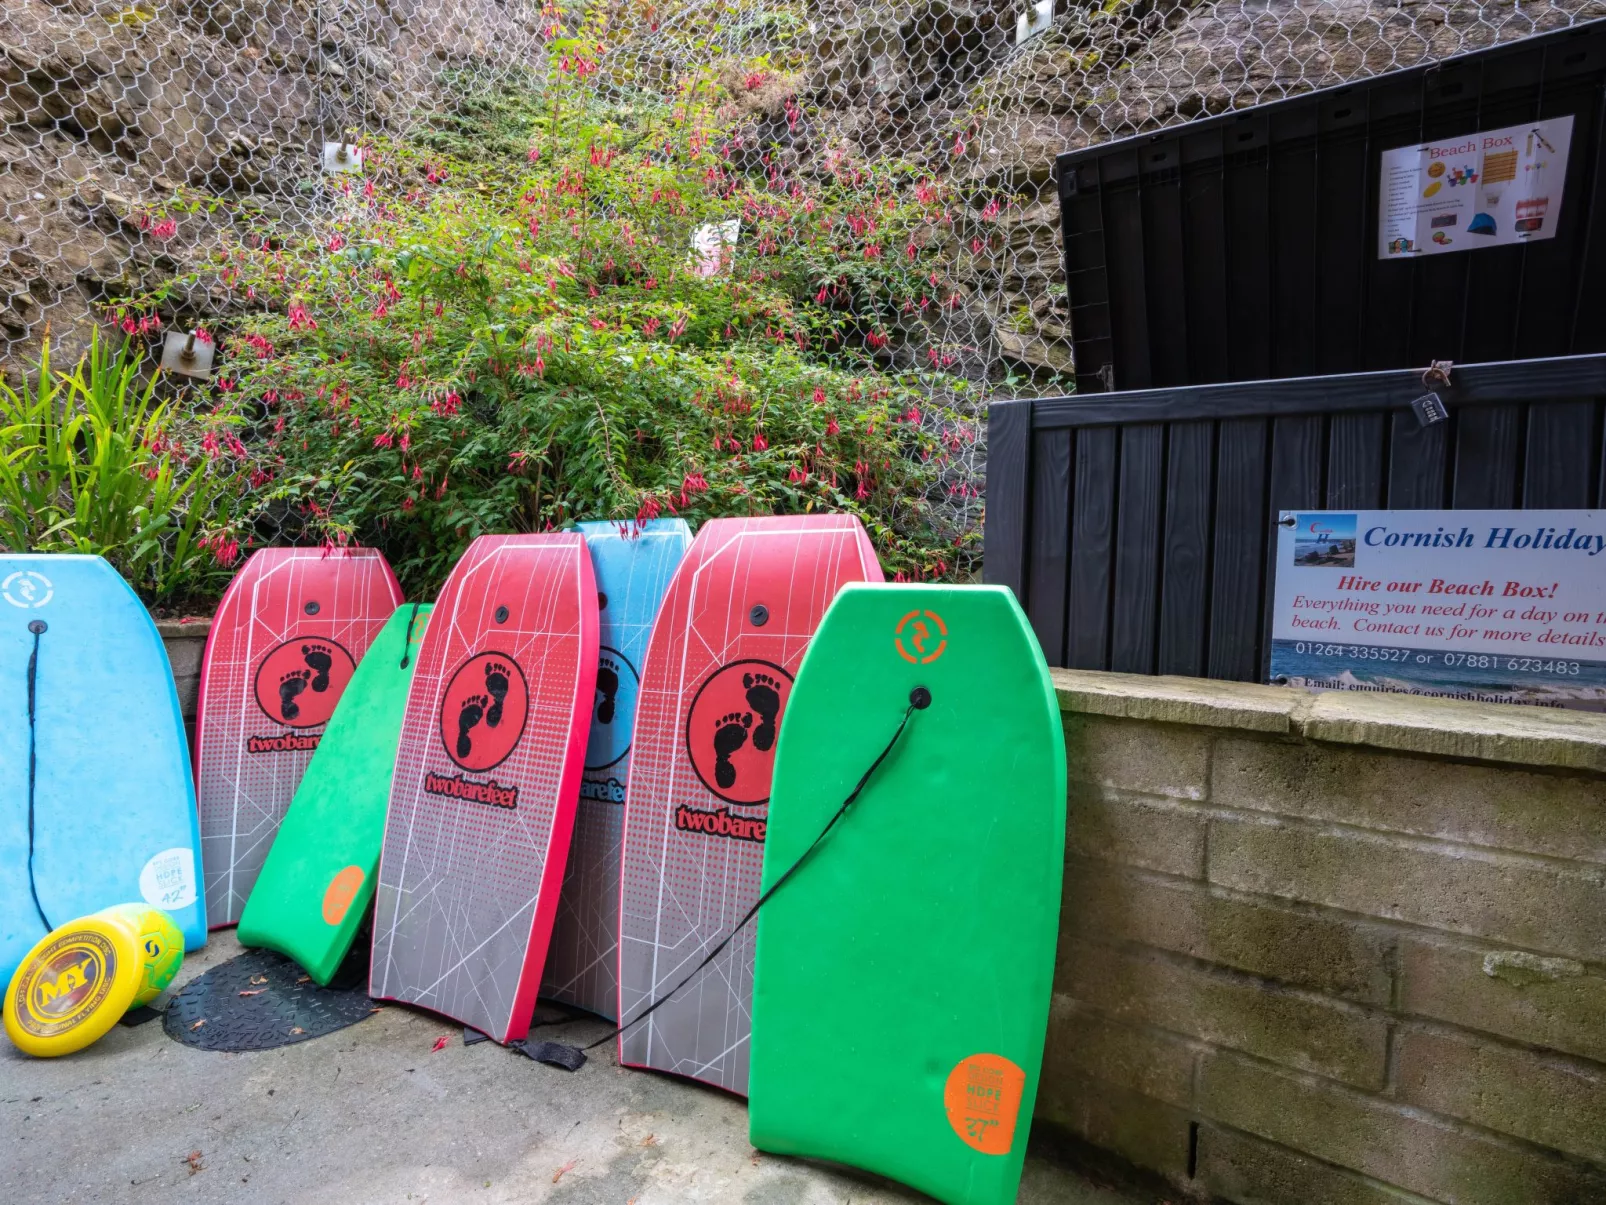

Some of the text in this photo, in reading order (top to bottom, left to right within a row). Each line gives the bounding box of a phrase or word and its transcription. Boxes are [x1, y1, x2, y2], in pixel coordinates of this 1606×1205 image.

[1429, 136, 1513, 159] Beach Box
[1364, 526, 1474, 549] Cornish
[1483, 527, 1606, 556] Holiday
[1336, 576, 1559, 598] Hire our Beach Box!
[1292, 595, 1606, 625] Everything you need for a day on t
[1291, 615, 1341, 630] beach.
[1353, 619, 1421, 635] Contact
[1425, 624, 1445, 637] us
[1445, 623, 1478, 641] for
[1482, 629, 1532, 642] more
[1295, 642, 1580, 676] 01264 335527 or 07881 623483
[1304, 677, 1564, 708] Email: enquiries@cornishholidayinfo
[248, 733, 322, 753] twobar
[425, 772, 519, 810] twobarefeet
[675, 804, 767, 843] twobare
